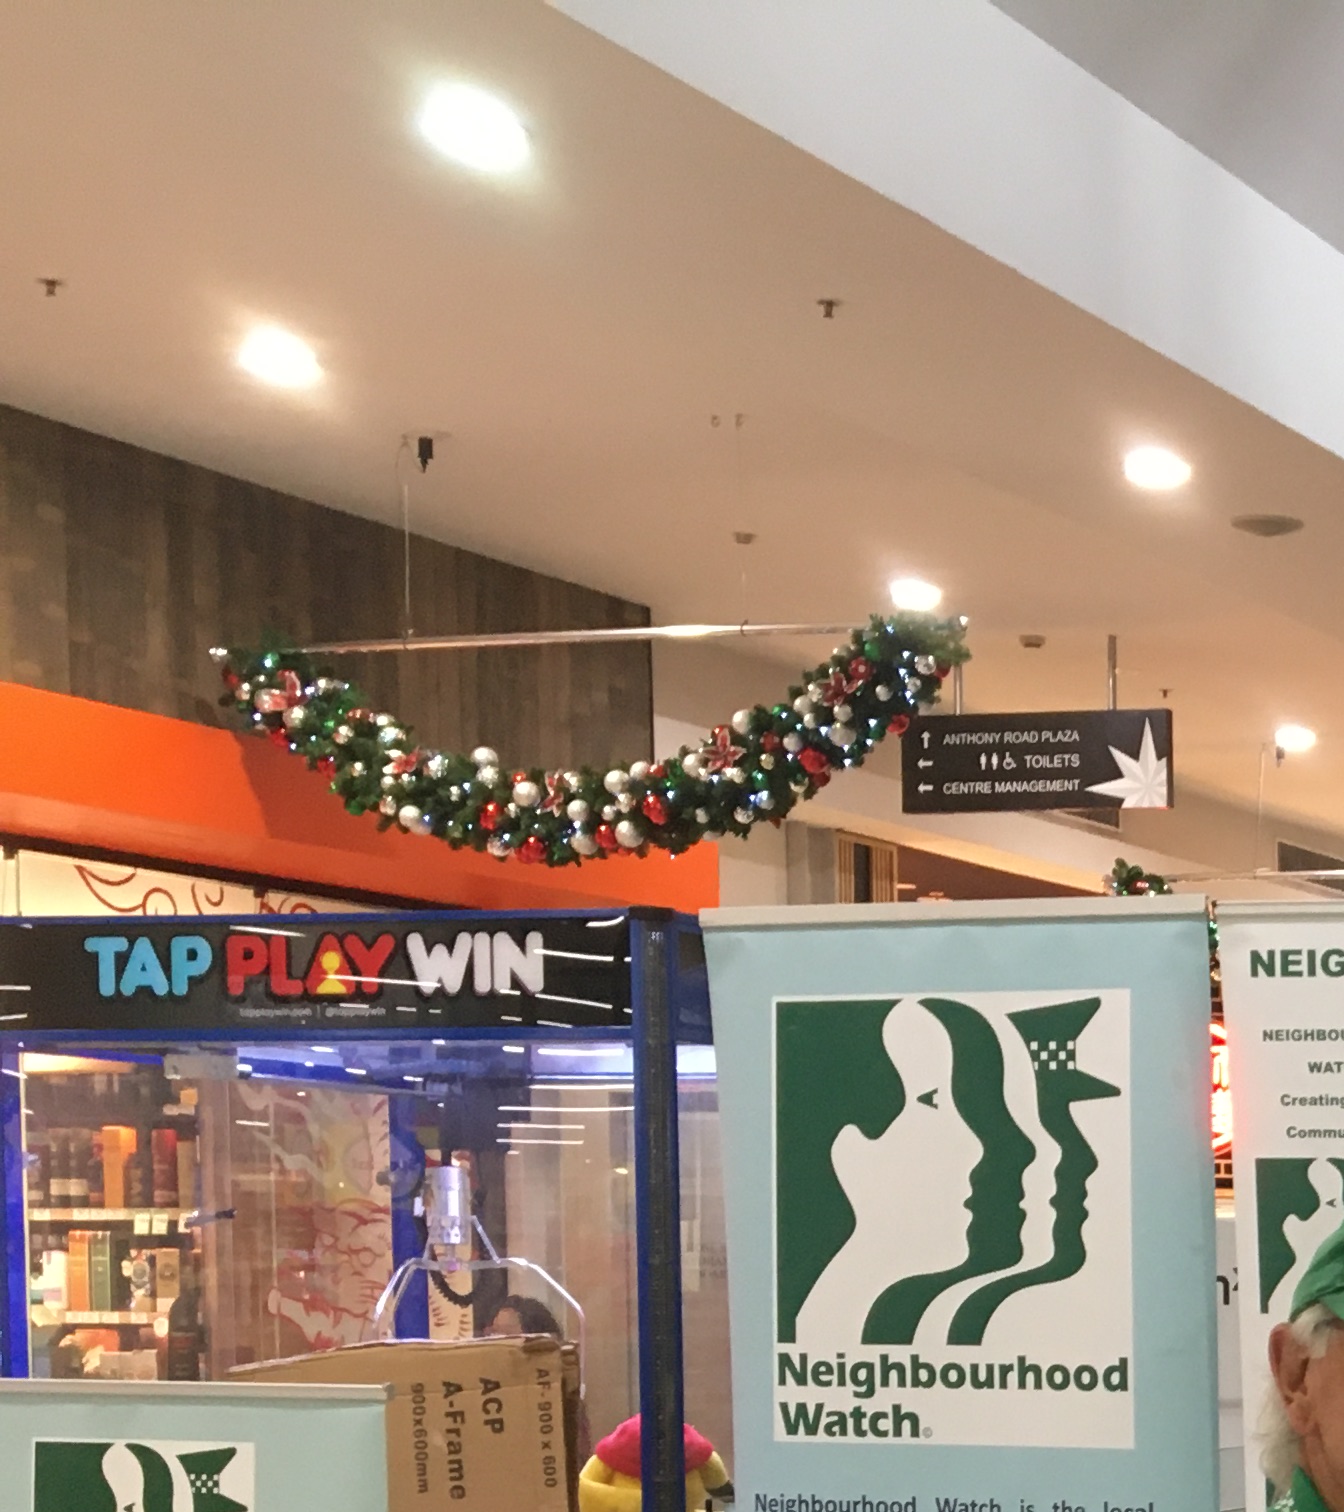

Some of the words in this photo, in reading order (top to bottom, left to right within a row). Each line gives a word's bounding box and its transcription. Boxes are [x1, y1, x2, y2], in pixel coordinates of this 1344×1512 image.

[943, 732, 1001, 745] ANTHONY
[1004, 731, 1038, 744] ROAD
[1041, 730, 1079, 743] PLAZA
[1024, 754, 1080, 768] TOILETS
[943, 781, 992, 794] CENTRE
[995, 780, 1080, 793] MANAGEMENT
[84, 935, 212, 997] TAP
[226, 933, 395, 997] PLAY
[406, 931, 544, 997] WIN
[777, 1353, 1129, 1398] Neighbourhood
[479, 1377, 504, 1434] ACP
[780, 1402, 920, 1438] Watch
[442, 1380, 465, 1500] A-Frame
